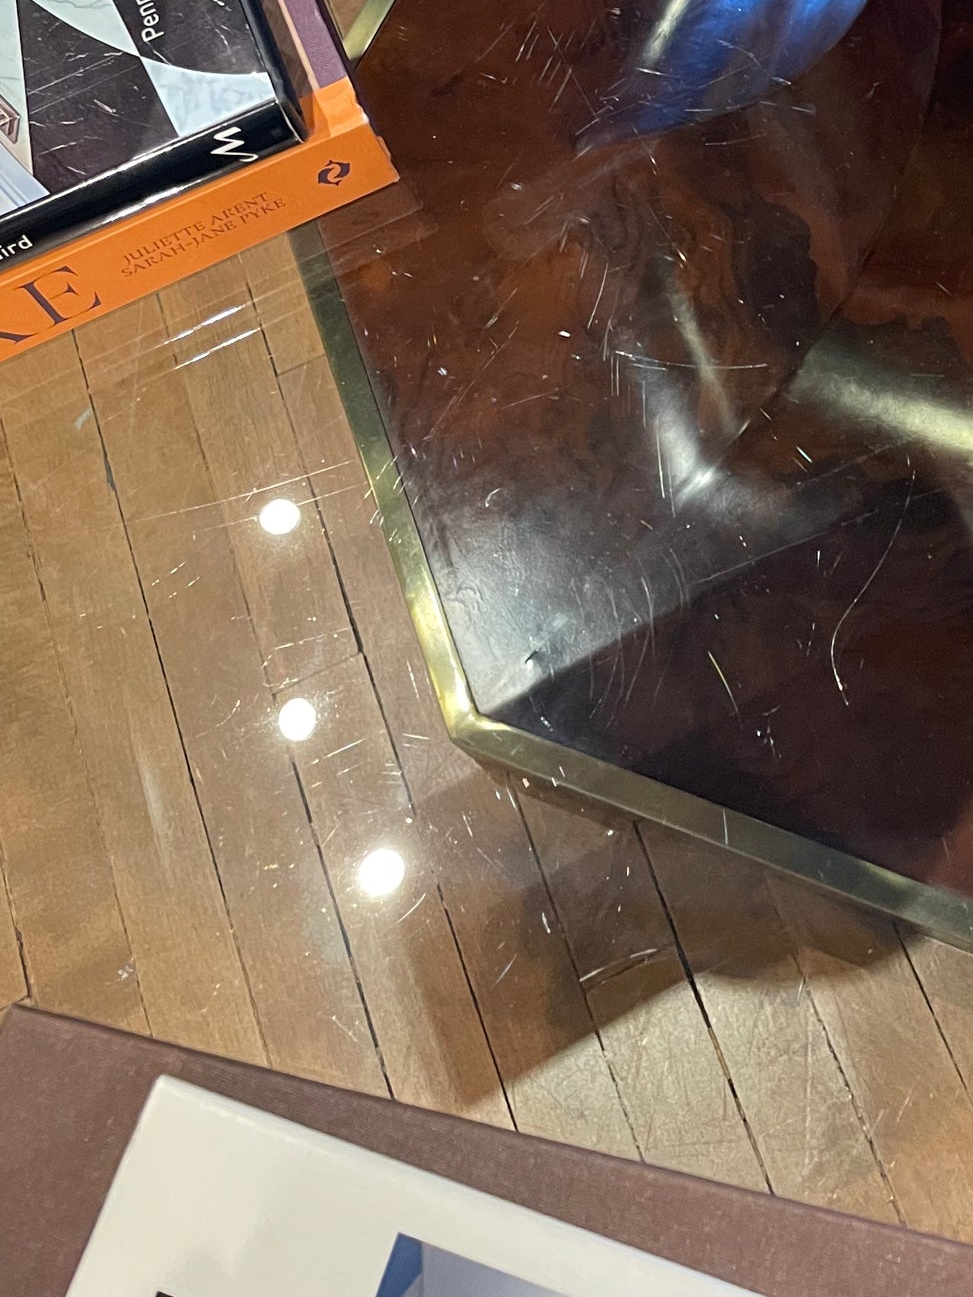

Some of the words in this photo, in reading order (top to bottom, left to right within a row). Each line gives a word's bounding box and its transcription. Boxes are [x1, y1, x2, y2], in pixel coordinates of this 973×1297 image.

[121, 219, 237, 278] SARAH-JANE
[240, 198, 287, 225] PYKE
[125, 220, 205, 266] JULIETTE
[211, 191, 271, 227] ARENT
[0, 265, 102, 345] E
